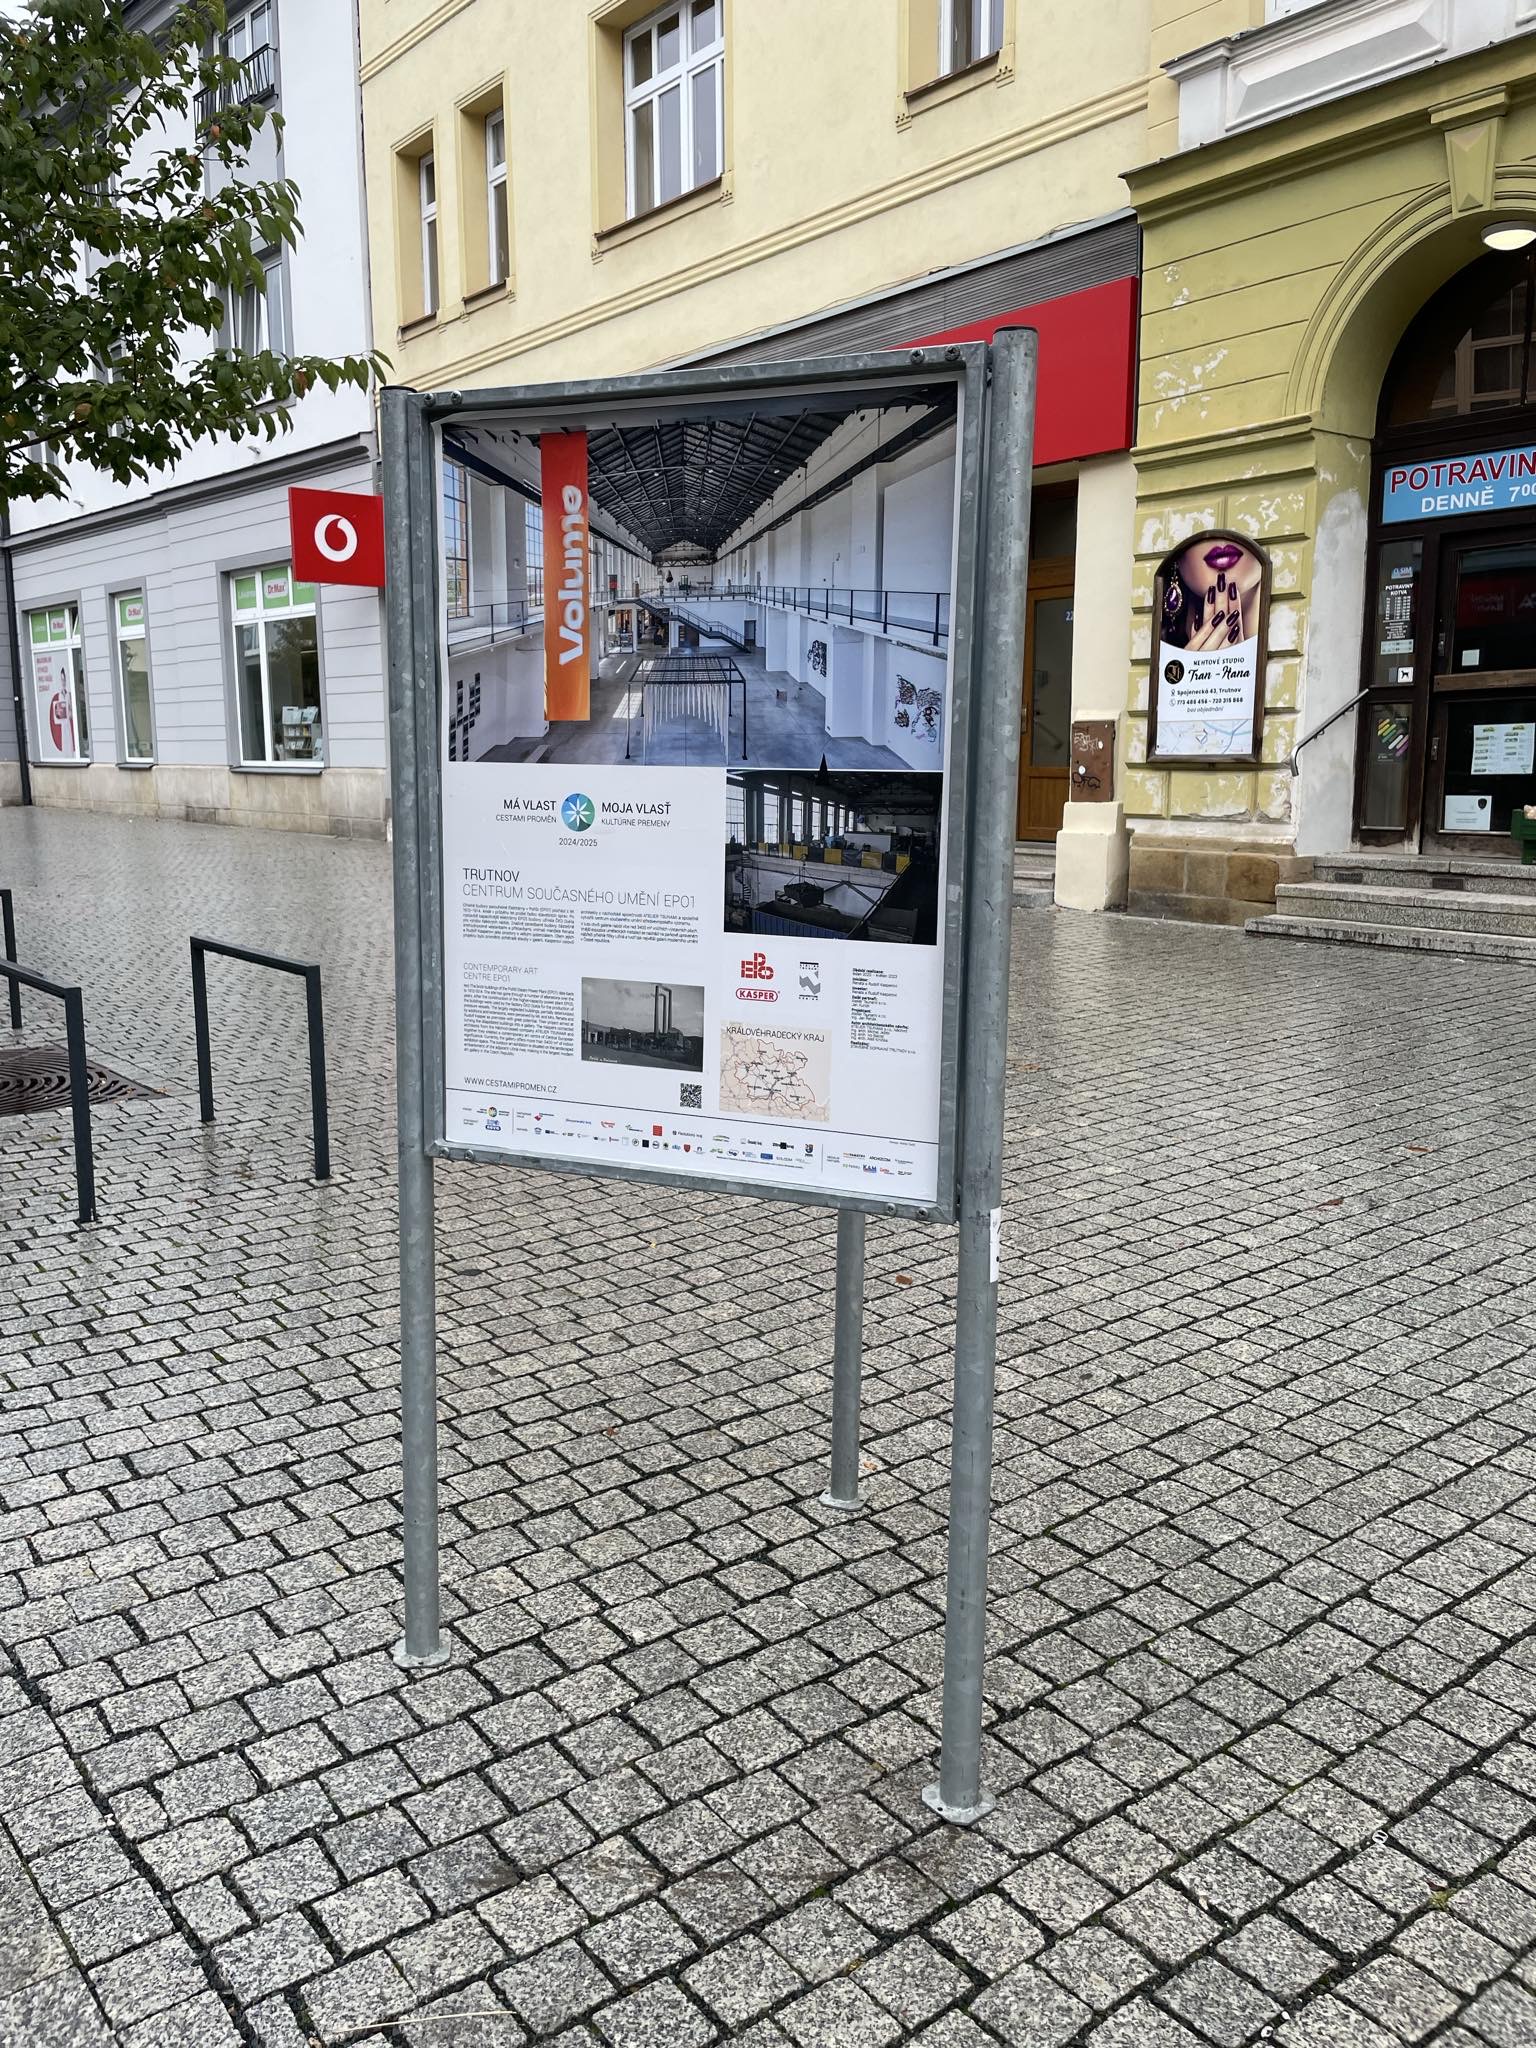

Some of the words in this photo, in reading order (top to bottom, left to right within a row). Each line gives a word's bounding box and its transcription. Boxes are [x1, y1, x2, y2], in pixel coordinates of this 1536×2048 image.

[1390, 450, 1536, 495] POTRAVIN
[1421, 485, 1495, 513] DENNĚ
[558, 485, 585, 665] Volume
[1193, 658, 1220, 666] NEHTOVÉ
[1188, 668, 1212, 683] Tran
[1221, 665, 1250, 680] Hana
[503, 797, 520, 811] MÁ
[523, 800, 557, 811] VLAST
[601, 801, 633, 814] MOJA
[635, 801, 672, 816] VLASŤ
[495, 814, 526, 823] CESTAMI
[526, 814, 557, 824] PROMĚN
[601, 816, 636, 827] KULTÚRNE
[637, 819, 671, 828] PREMENY
[558, 837, 598, 847] 2024/2025
[462, 867, 520, 883] TRUTNOV
[462, 884, 524, 899] CENTRUM
[527, 885, 614, 904] SOUČASNÉHO
[617, 889, 660, 907] UMĚNÍ
[463, 962, 522, 974] CONTEMPORARY
[523, 967, 539, 975] ART
[463, 972, 491, 981] CENTRE
[739, 989, 775, 1001] KASPER
[803, 1033, 825, 1043] KRAJ
[464, 1076, 558, 1094] WWW.CESTAMIPROMEN.CZ
